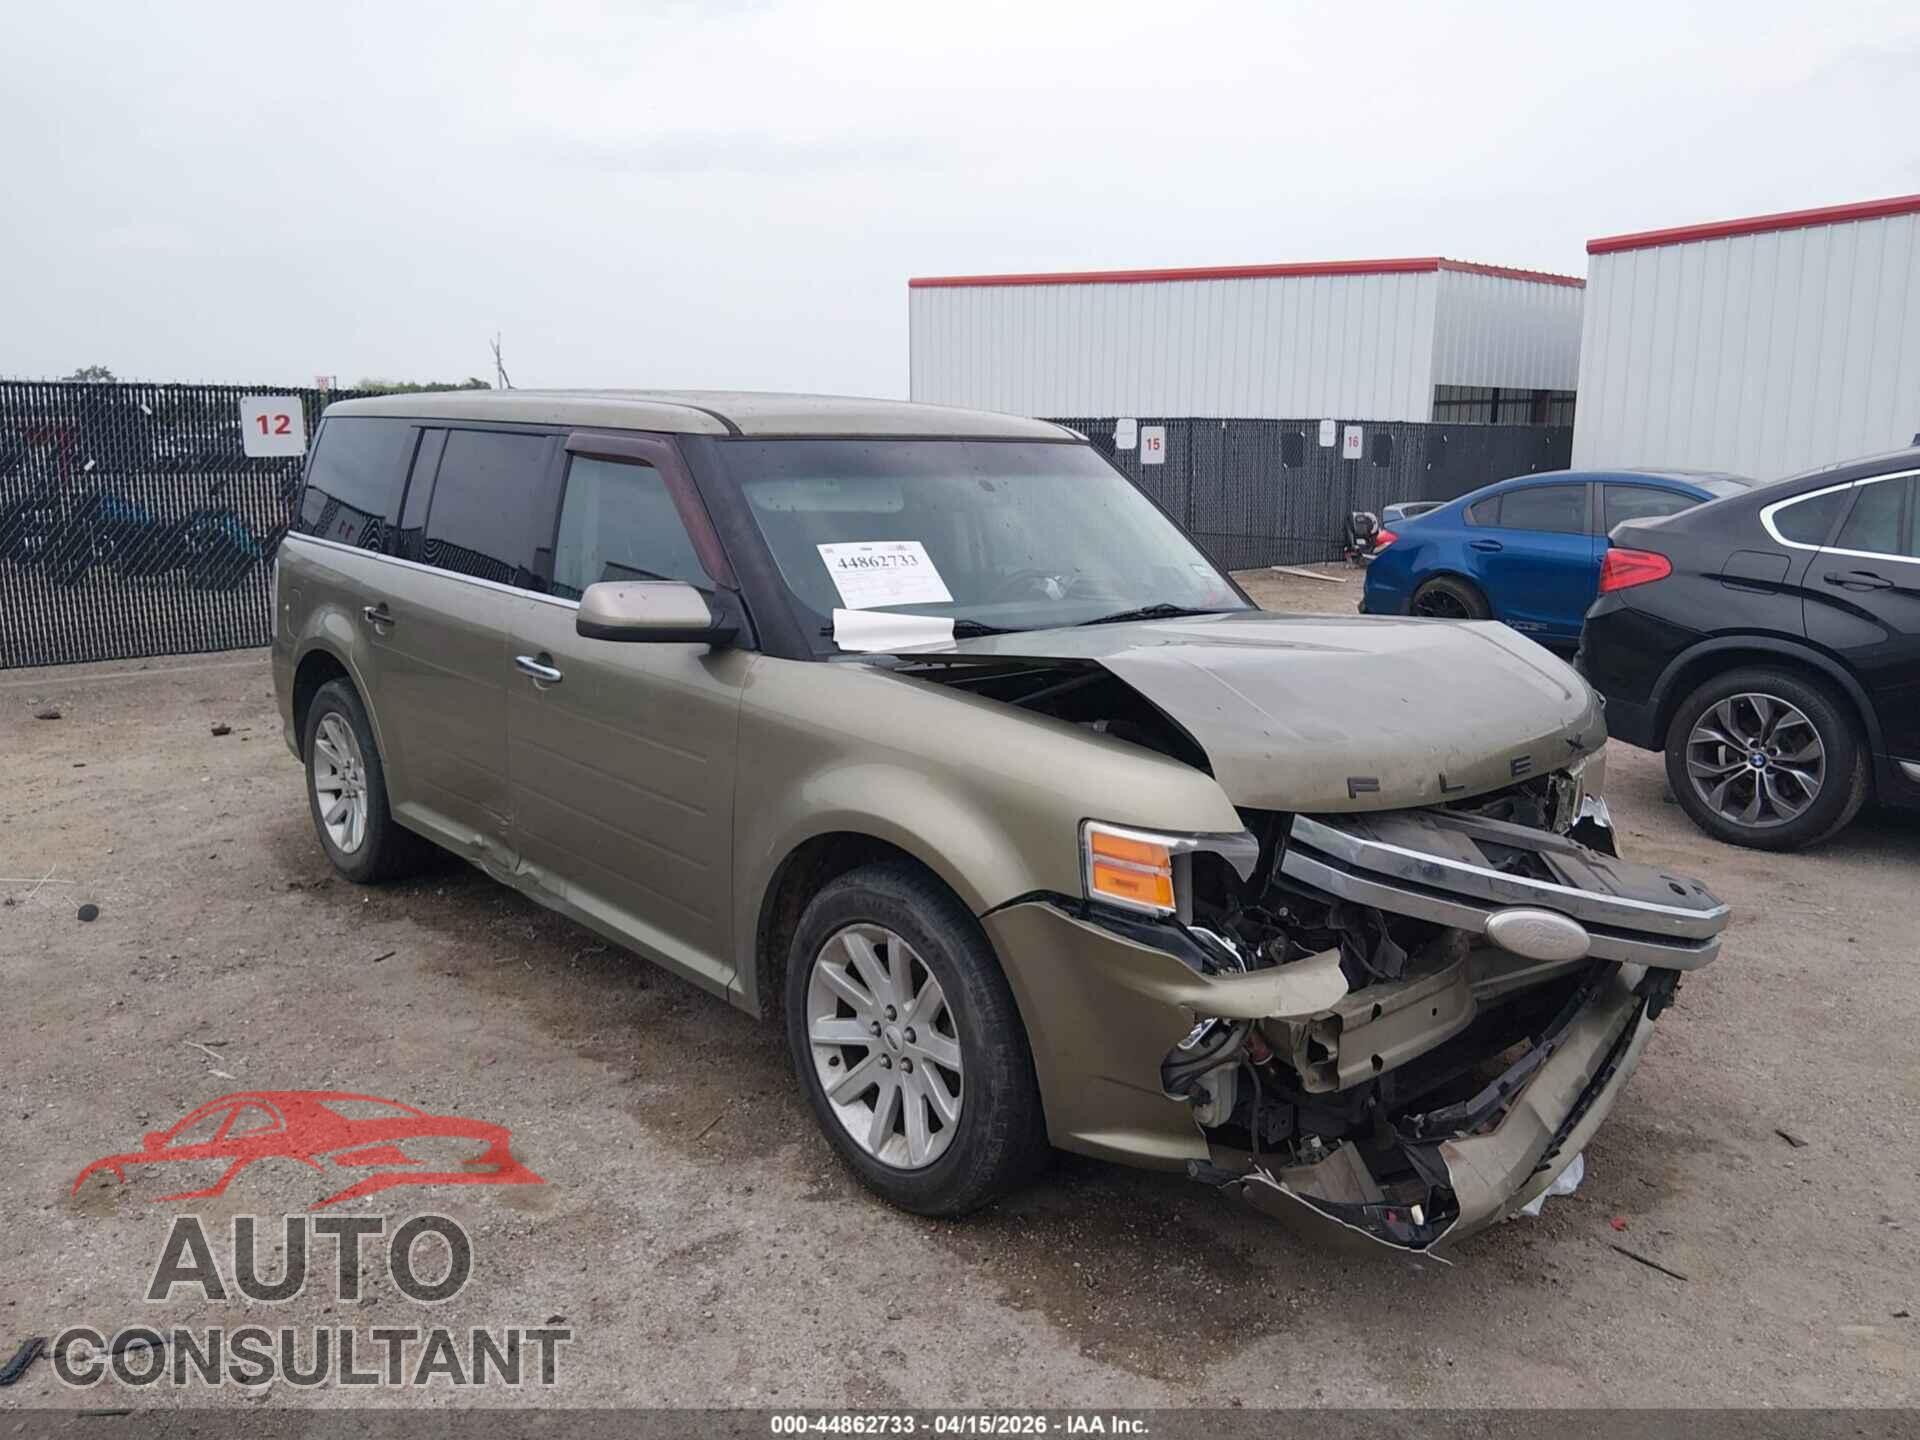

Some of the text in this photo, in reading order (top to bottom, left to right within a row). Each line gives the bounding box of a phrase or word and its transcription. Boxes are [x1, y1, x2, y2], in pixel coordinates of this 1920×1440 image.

[256, 414, 292, 435] 12
[1146, 437, 1161, 451] 15
[1347, 435, 1360, 448] 16
[837, 554, 919, 569] 44862733
[1346, 733, 1585, 800] FLEX
